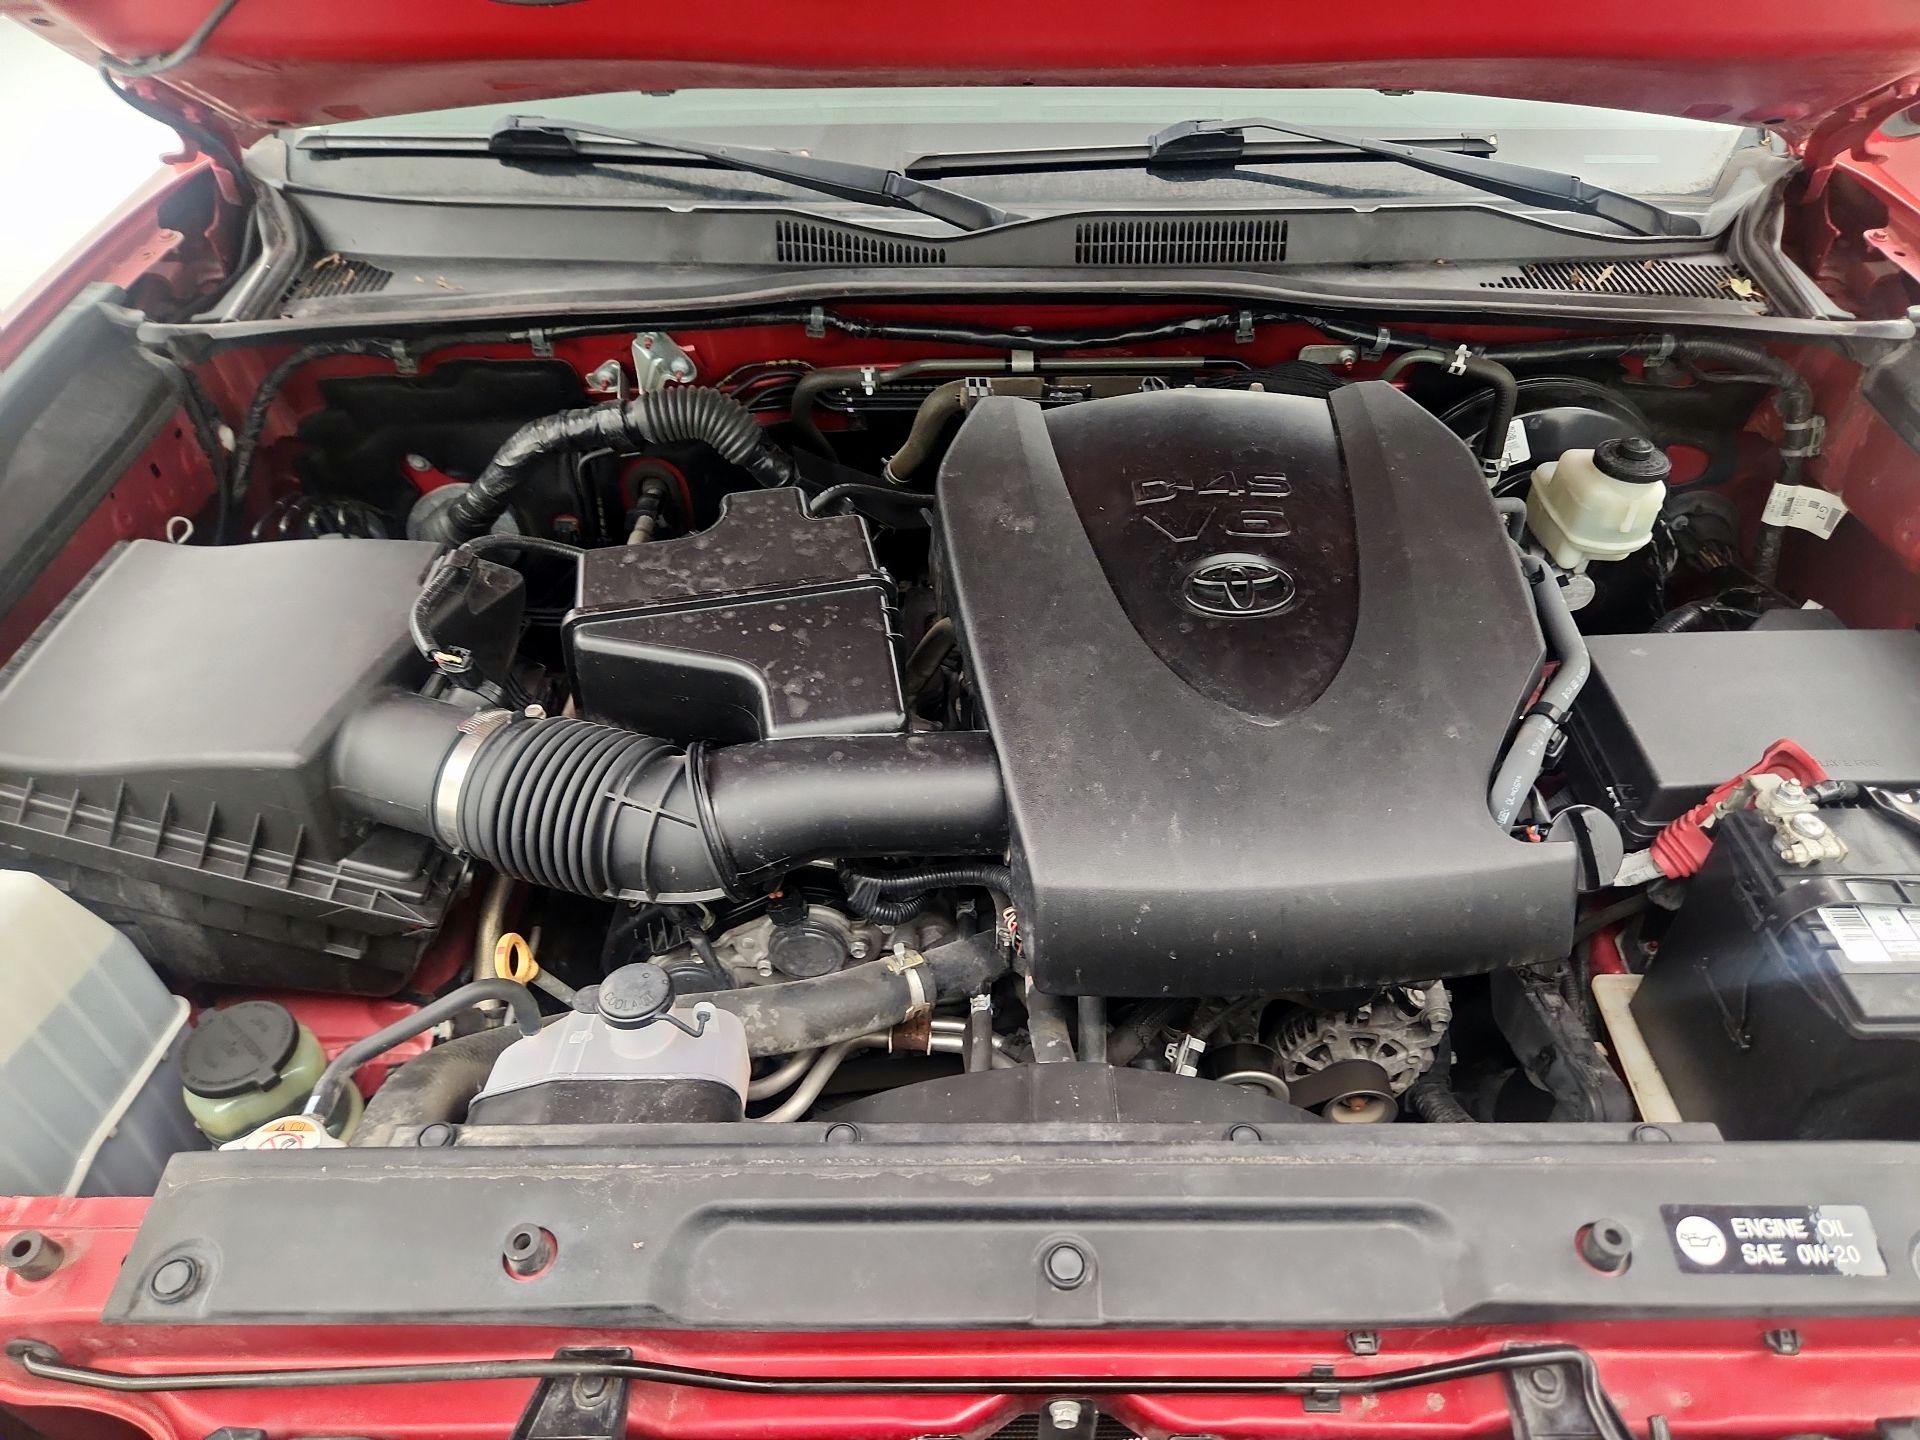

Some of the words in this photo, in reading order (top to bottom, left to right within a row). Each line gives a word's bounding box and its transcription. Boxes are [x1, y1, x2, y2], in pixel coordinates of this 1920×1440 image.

[1142, 505, 1292, 543] V6
[604, 991, 656, 1010] COOLANT
[1730, 1217, 1809, 1240] ENGINE
[1817, 1218, 1854, 1238] OIL
[1740, 1243, 1788, 1266] SAE
